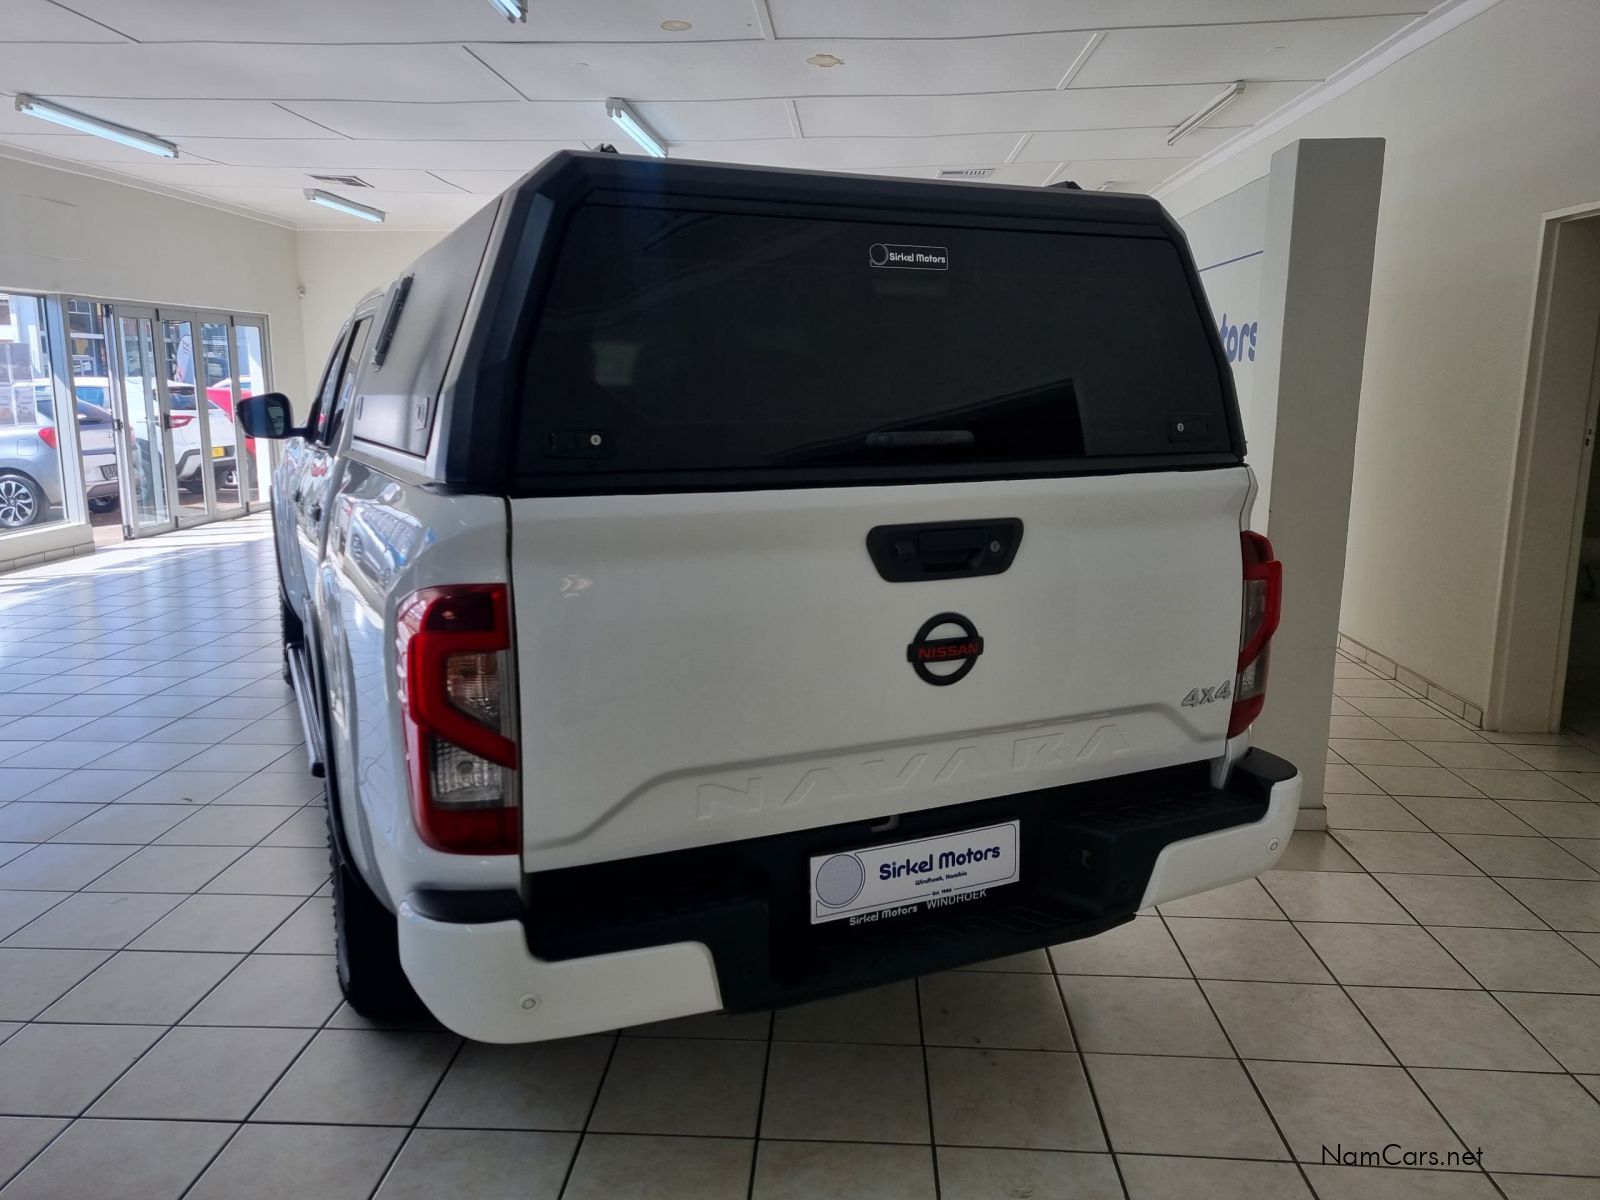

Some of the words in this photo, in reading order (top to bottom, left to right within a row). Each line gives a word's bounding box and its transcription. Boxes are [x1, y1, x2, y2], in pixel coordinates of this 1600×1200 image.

[889, 252, 915, 262] Sirkel
[916, 253, 946, 263] Motors
[918, 642, 978, 659] NISSAN
[697, 724, 1131, 820] NAVARA
[879, 853, 934, 880] Sirkel
[938, 846, 1001, 870] Motors
[849, 910, 879, 926] Sirkel
[881, 905, 918, 919] Motors
[926, 888, 987, 910] WINDHOEK
